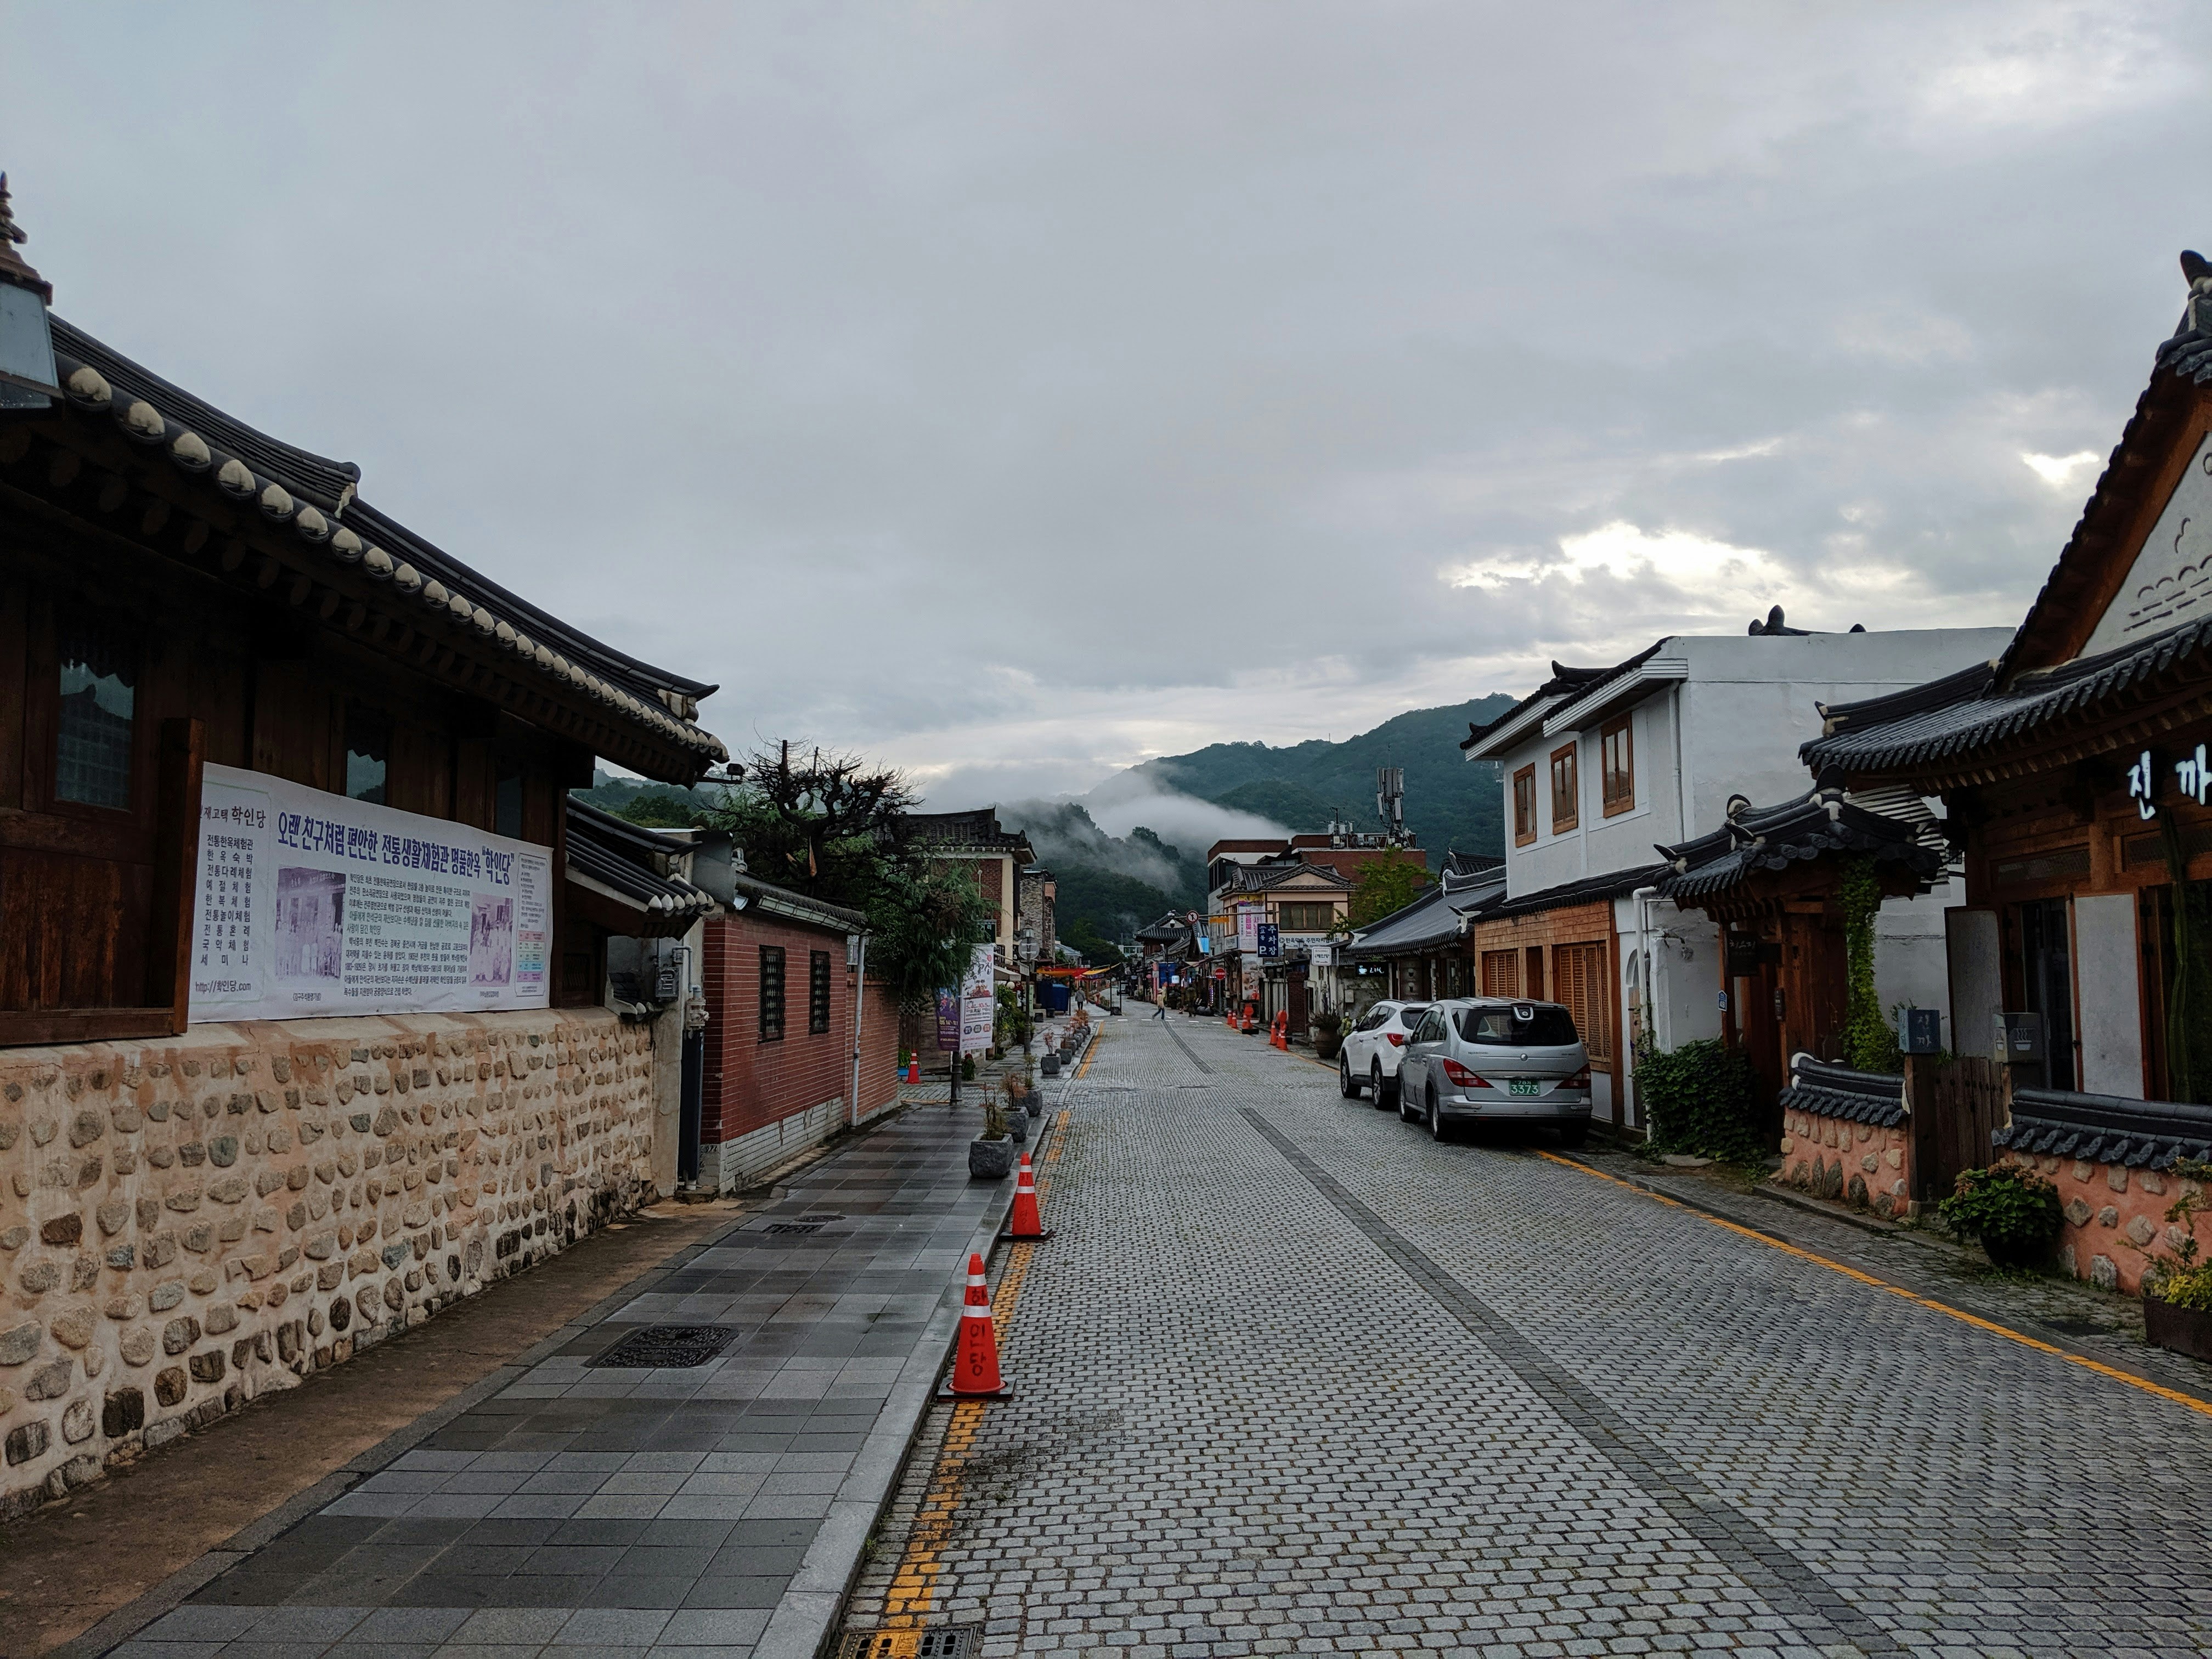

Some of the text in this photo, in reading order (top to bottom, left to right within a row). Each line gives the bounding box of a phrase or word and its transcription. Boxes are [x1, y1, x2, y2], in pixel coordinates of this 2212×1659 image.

[201, 805, 266, 829] 재고택 학인당
[278, 811, 300, 848] 오랜
[302, 815, 345, 856] 친구처럼
[347, 827, 378, 861] 편안한
[1259, 946, 1267, 955] P
[1268, 925, 1277, 955] 주차장
[1511, 1085, 1538, 1093] 3373
